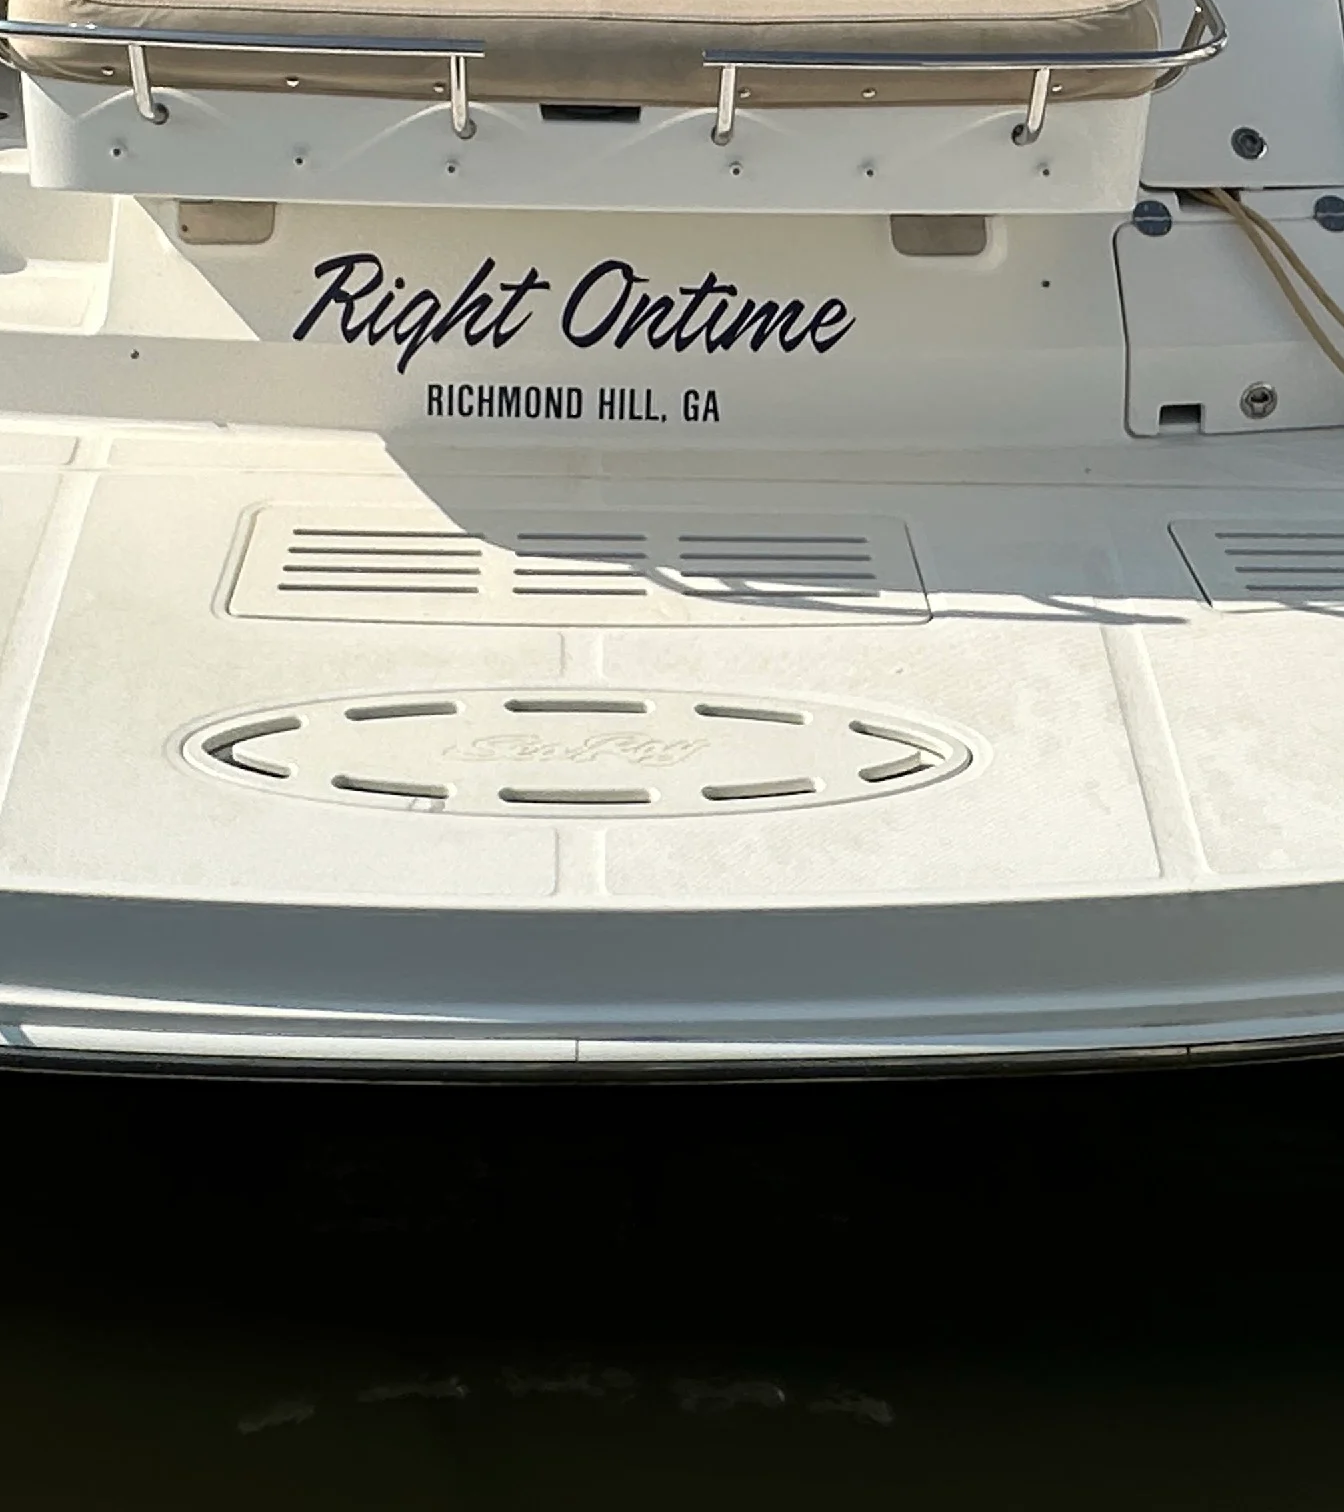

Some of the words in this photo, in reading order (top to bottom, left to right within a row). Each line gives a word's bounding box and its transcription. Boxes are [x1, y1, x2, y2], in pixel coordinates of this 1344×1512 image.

[292, 252, 551, 375] Right
[561, 259, 857, 354] Ontime
[427, 384, 583, 419] RICHMOND
[598, 388, 667, 423] HILL,
[682, 389, 721, 423] GA
